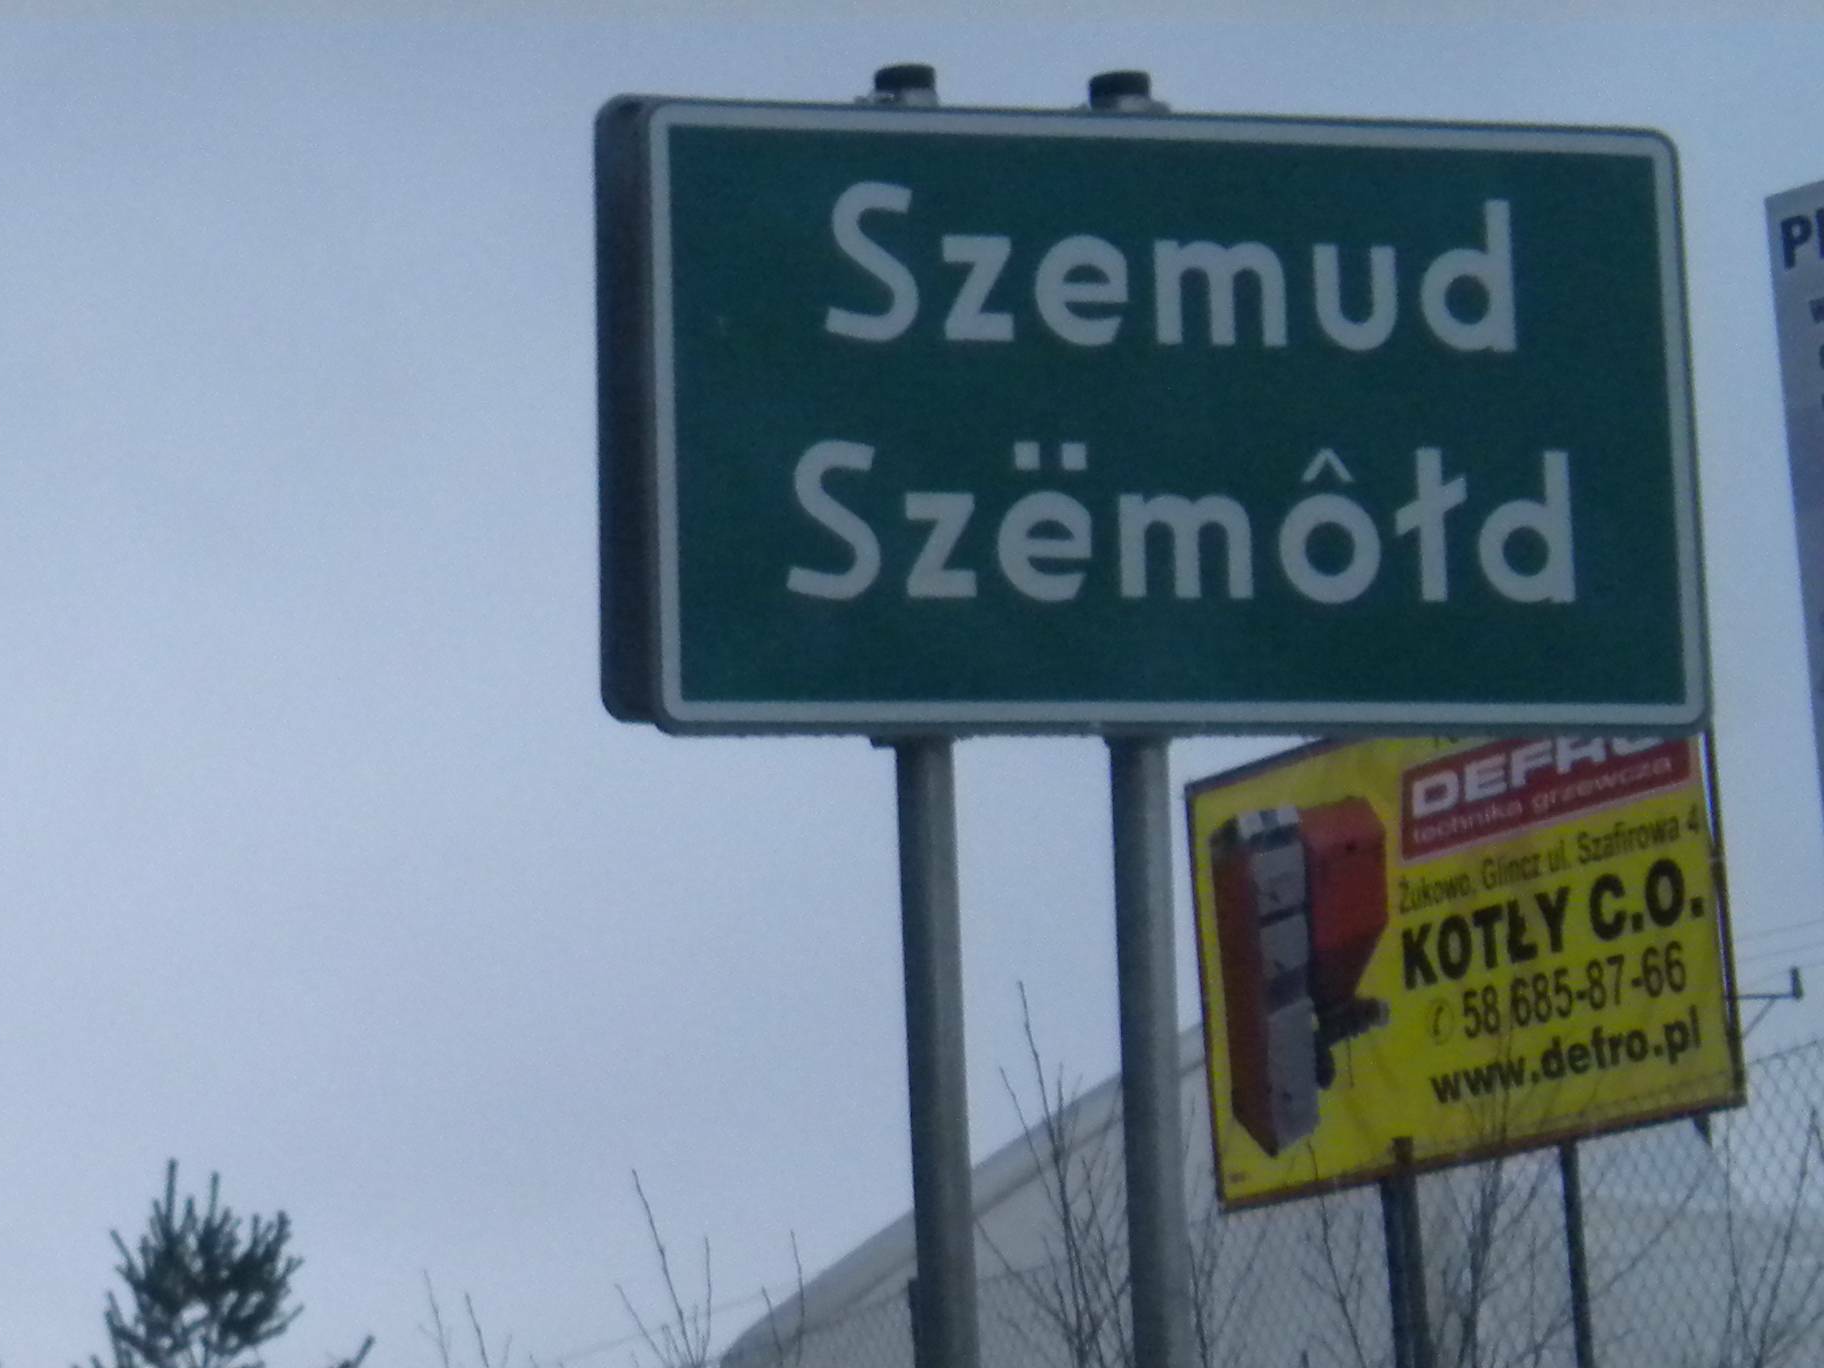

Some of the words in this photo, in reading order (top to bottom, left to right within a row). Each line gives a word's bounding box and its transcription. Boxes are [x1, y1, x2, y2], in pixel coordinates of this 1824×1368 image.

[825, 181, 1517, 352] Szemud
[785, 439, 1574, 603] Szëmôłd
[1413, 799, 1523, 843] technika
[1532, 756, 1672, 814] grzewcza
[1577, 815, 1680, 863] Szafirowa
[1687, 804, 1699, 832] 4
[1402, 886, 1569, 991] KOTŁY
[1588, 858, 1705, 942] C.O.
[1463, 984, 1500, 1038] 58
[1510, 940, 1686, 1026] 685-87-66
[1429, 1004, 1700, 1104] www.defro.pl
